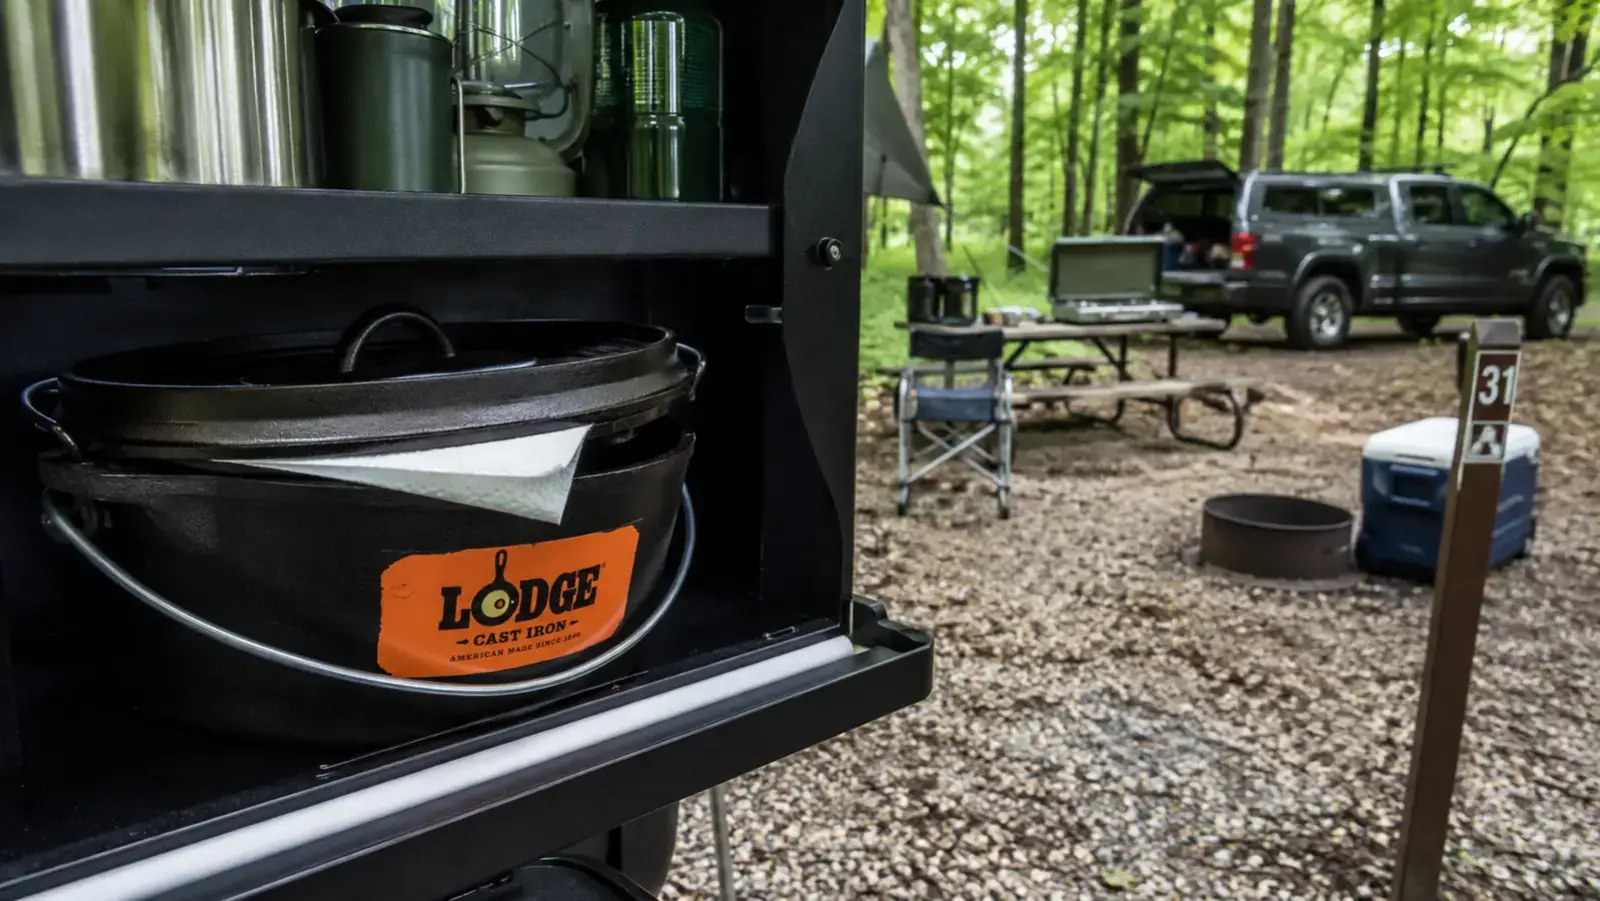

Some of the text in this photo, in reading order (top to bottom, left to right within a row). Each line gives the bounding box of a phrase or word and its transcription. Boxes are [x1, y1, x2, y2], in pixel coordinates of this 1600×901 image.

[1478, 364, 1516, 406] 31
[438, 564, 601, 630] LODGE
[449, 648, 504, 662] AMERICAN
[507, 644, 533, 654] MADE
[535, 637, 561, 649] SINCE
[473, 620, 567, 646] CAST IRON
